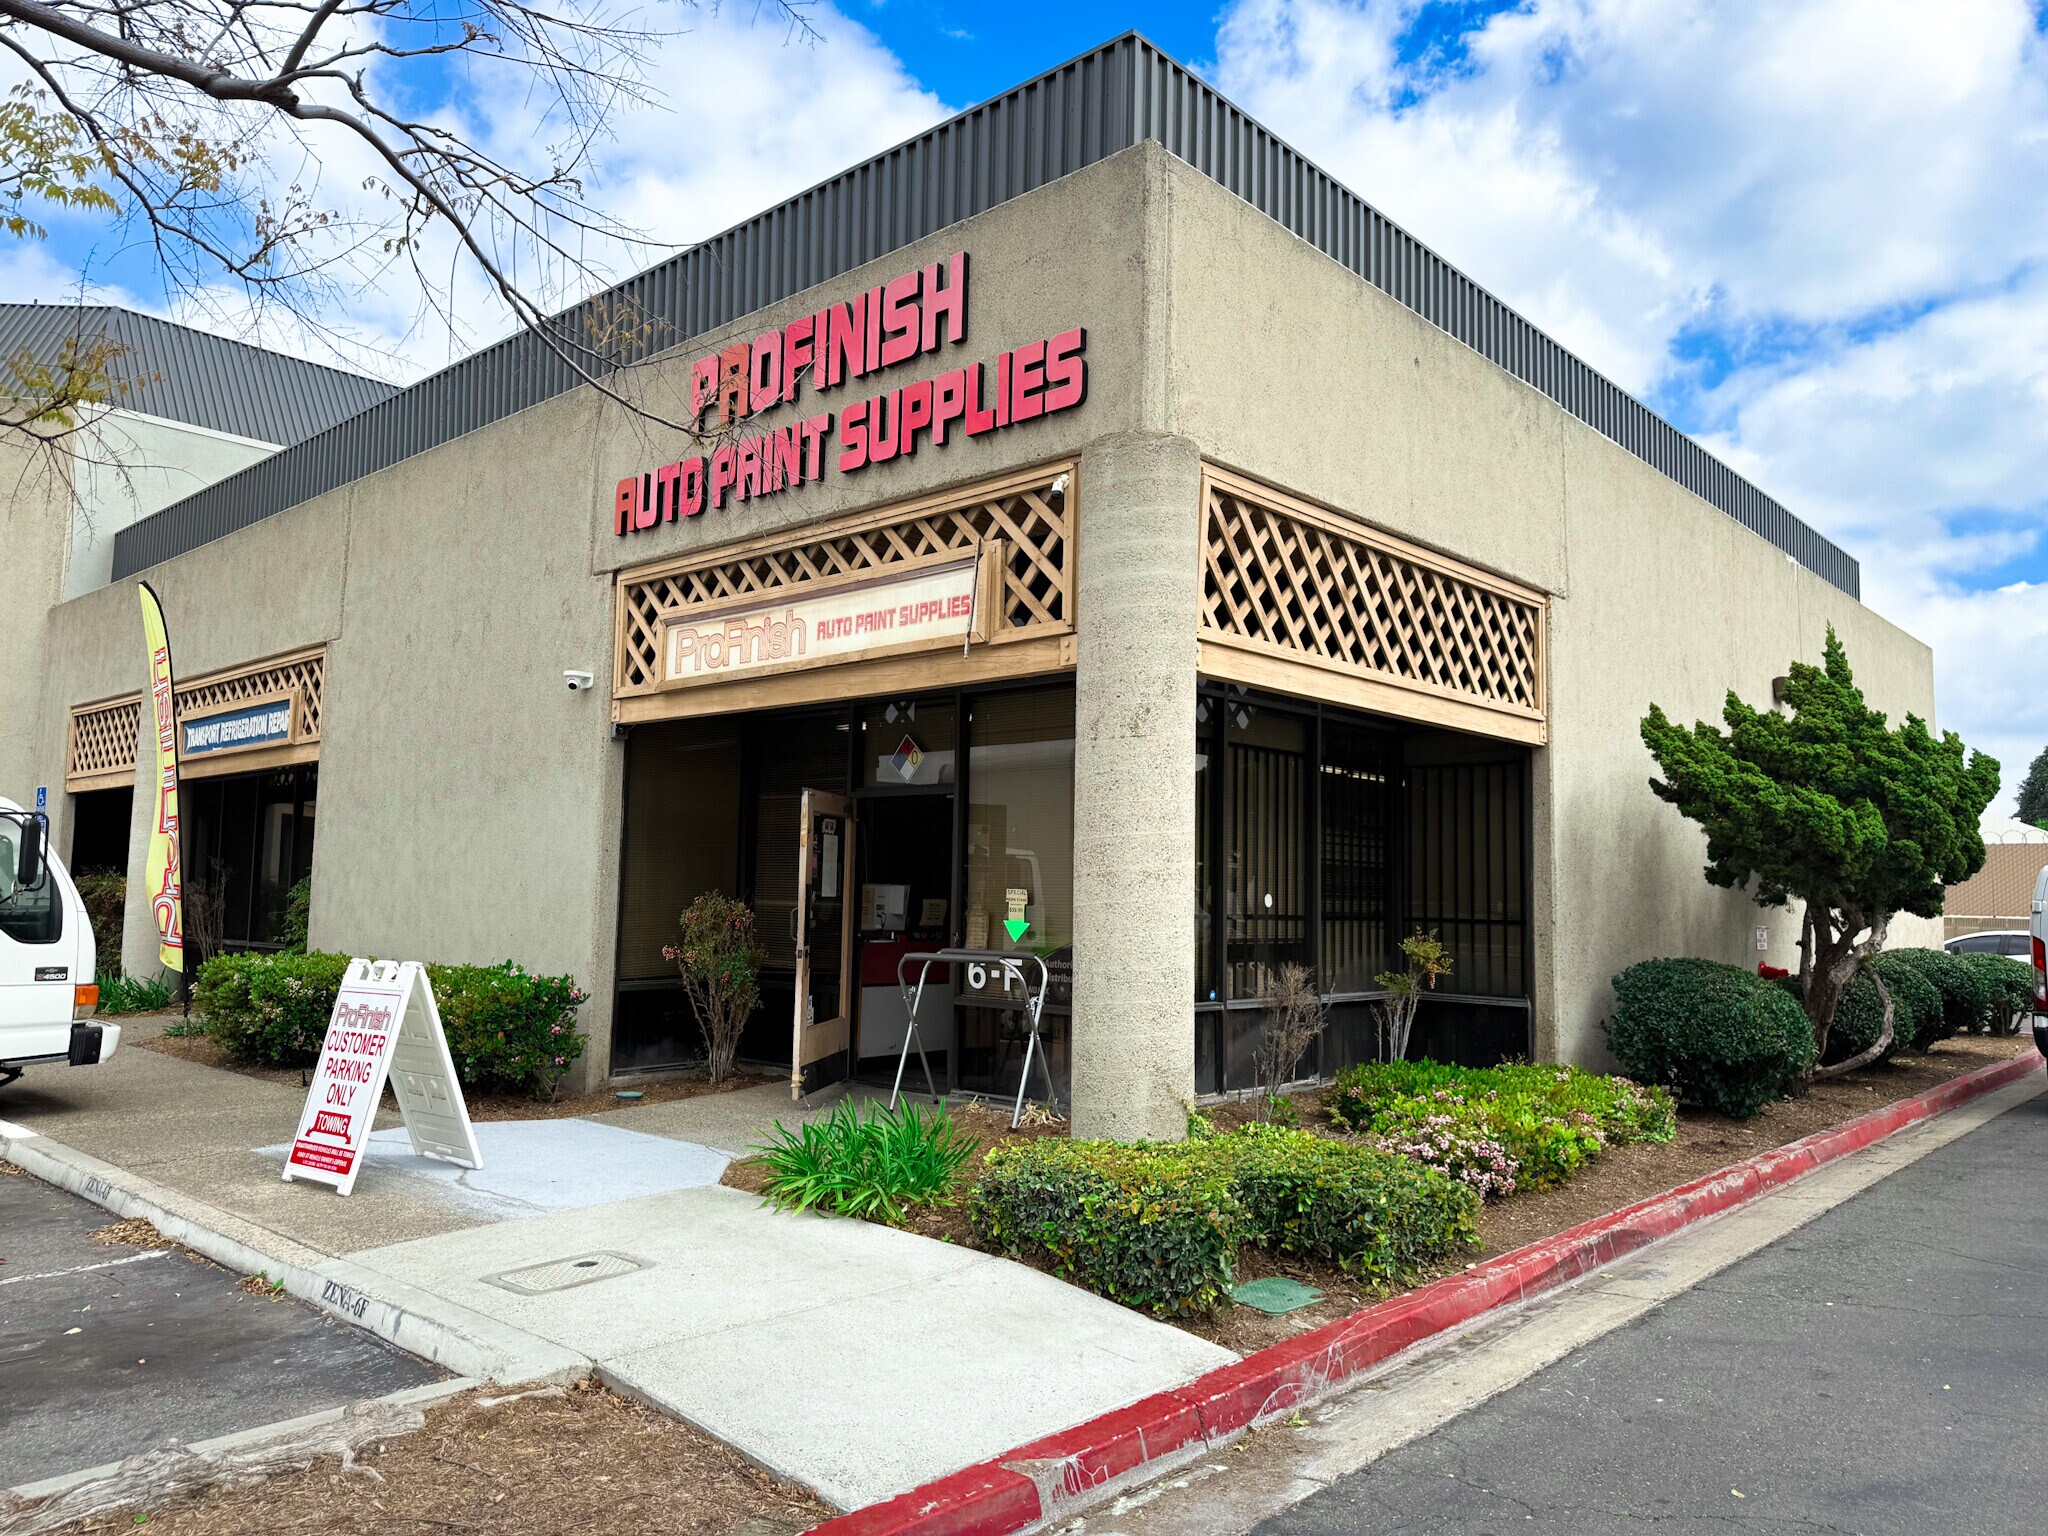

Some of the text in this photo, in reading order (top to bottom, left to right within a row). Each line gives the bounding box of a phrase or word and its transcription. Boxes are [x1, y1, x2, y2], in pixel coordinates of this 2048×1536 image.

[691, 251, 969, 430] PROFINISH
[614, 326, 1087, 535] AUTO PAINT SUPPLIES
[675, 594, 970, 674] ProFinish AUTO PAINT SUPPLIES
[185, 723, 220, 751] TRANSPORT
[219, 712, 269, 743] REFRIGERATION
[335, 1002, 391, 1031] ProFinish
[327, 1029, 386, 1057] CUSTOMER
[323, 1057, 372, 1083] PARKING
[326, 1082, 357, 1107] ONLY
[316, 1113, 349, 1134] TOWING
[321, 1279, 370, 1319] ZENA-6F
